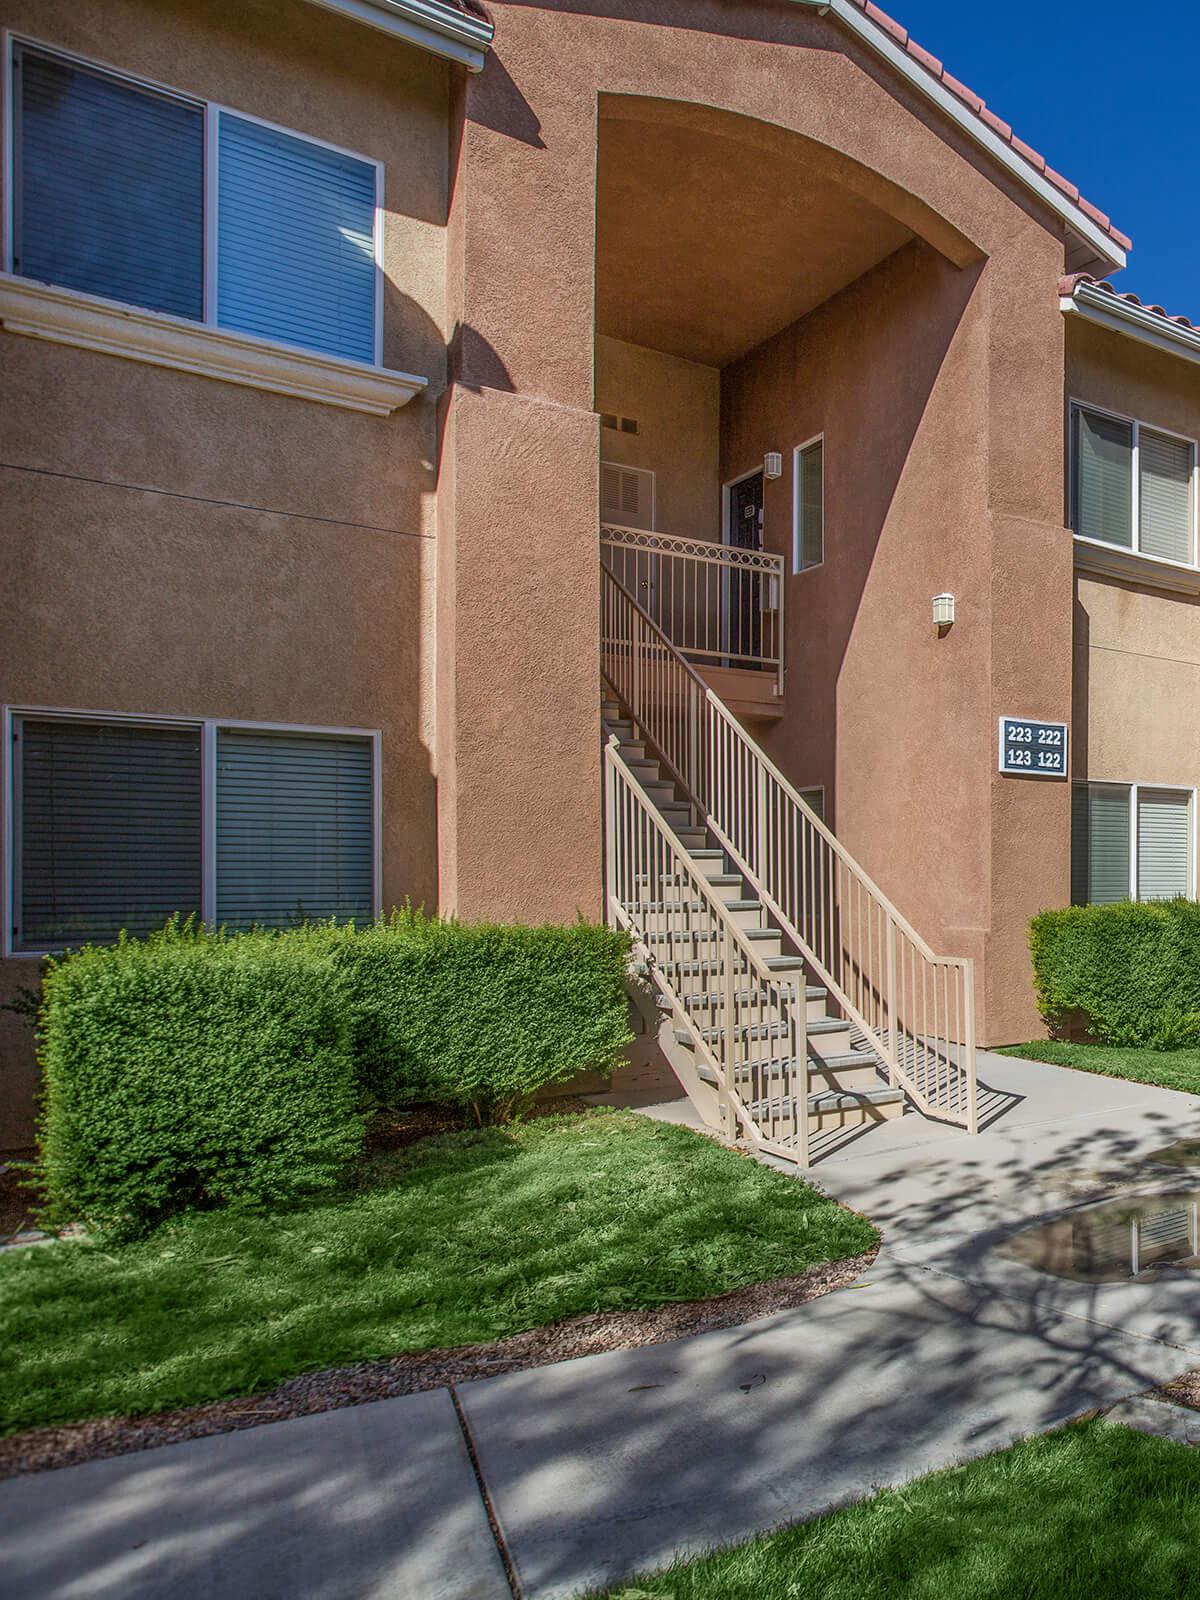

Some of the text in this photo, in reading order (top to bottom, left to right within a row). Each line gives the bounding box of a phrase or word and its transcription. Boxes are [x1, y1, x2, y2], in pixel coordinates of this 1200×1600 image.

[1008, 726, 1061, 745] 223 222
[1008, 749, 1061, 768] 123 122
